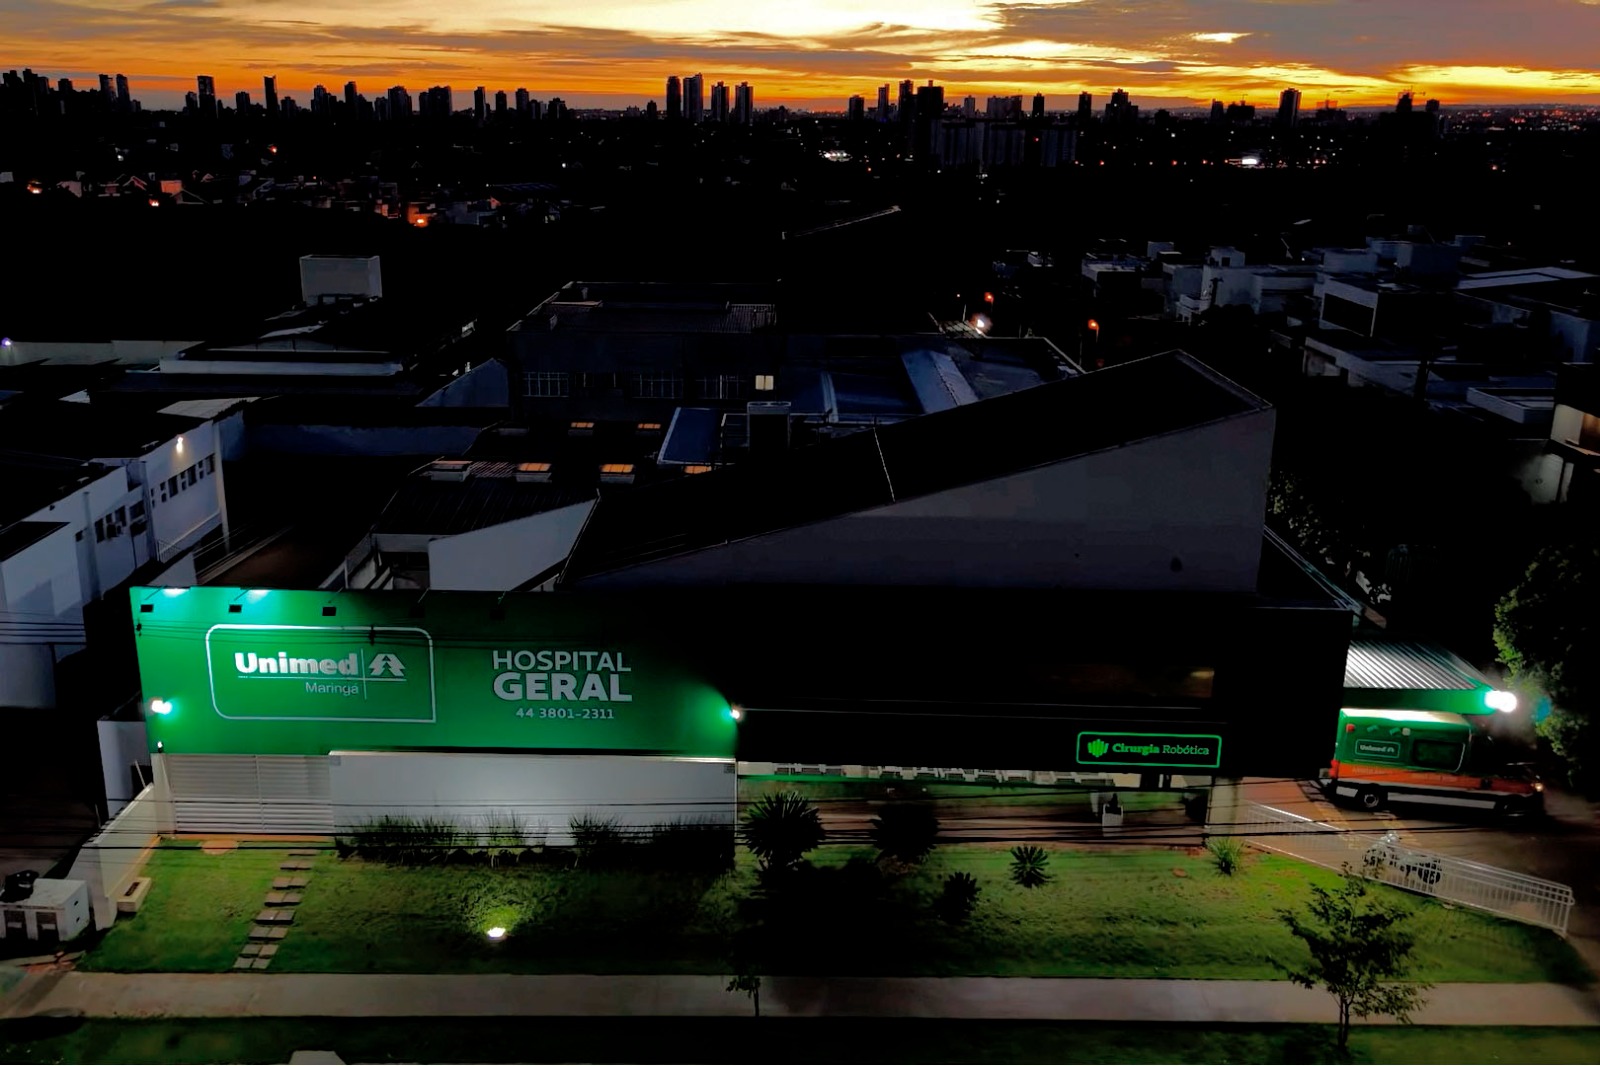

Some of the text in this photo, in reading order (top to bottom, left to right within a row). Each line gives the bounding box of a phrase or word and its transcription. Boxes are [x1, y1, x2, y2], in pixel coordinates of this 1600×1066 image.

[234, 651, 359, 675] Unimed
[493, 650, 632, 672] HOSPITAL
[305, 682, 359, 697] Maringá
[493, 671, 633, 702] GERAL
[516, 708, 614, 719] 44 3801-2311
[1112, 742, 1209, 756] Cirurgia Robótica
